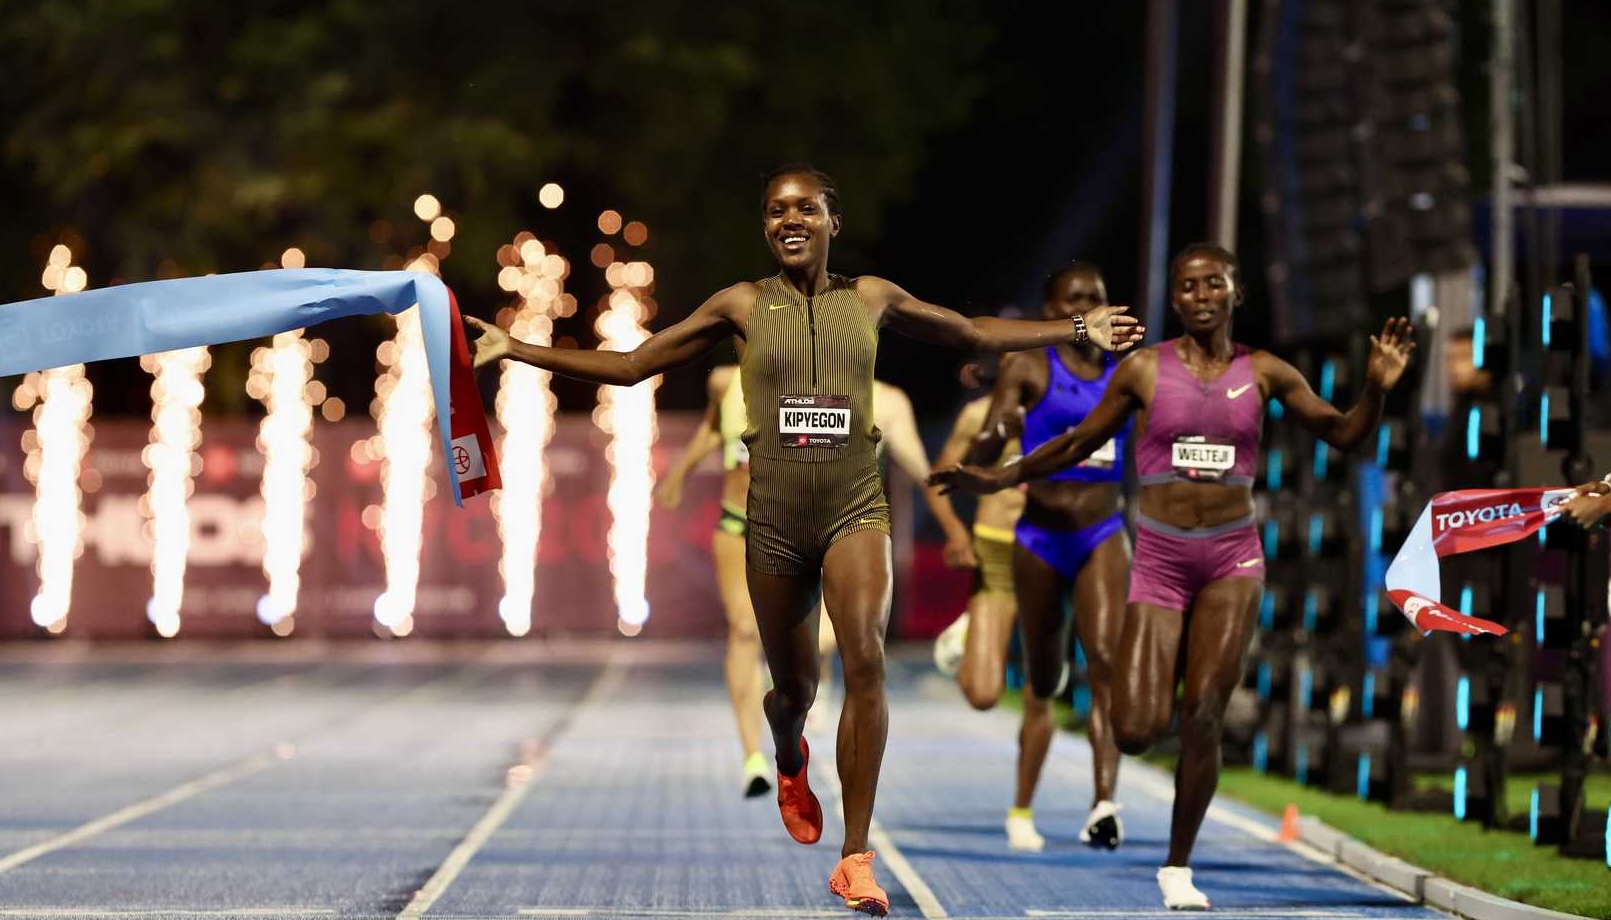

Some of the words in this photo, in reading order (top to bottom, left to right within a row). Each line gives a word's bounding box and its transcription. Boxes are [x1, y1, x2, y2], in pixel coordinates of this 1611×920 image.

[784, 411, 846, 429] KIPYEGON
[1178, 447, 1229, 463] WELTEJI
[1436, 502, 1526, 531] TOYOTA
